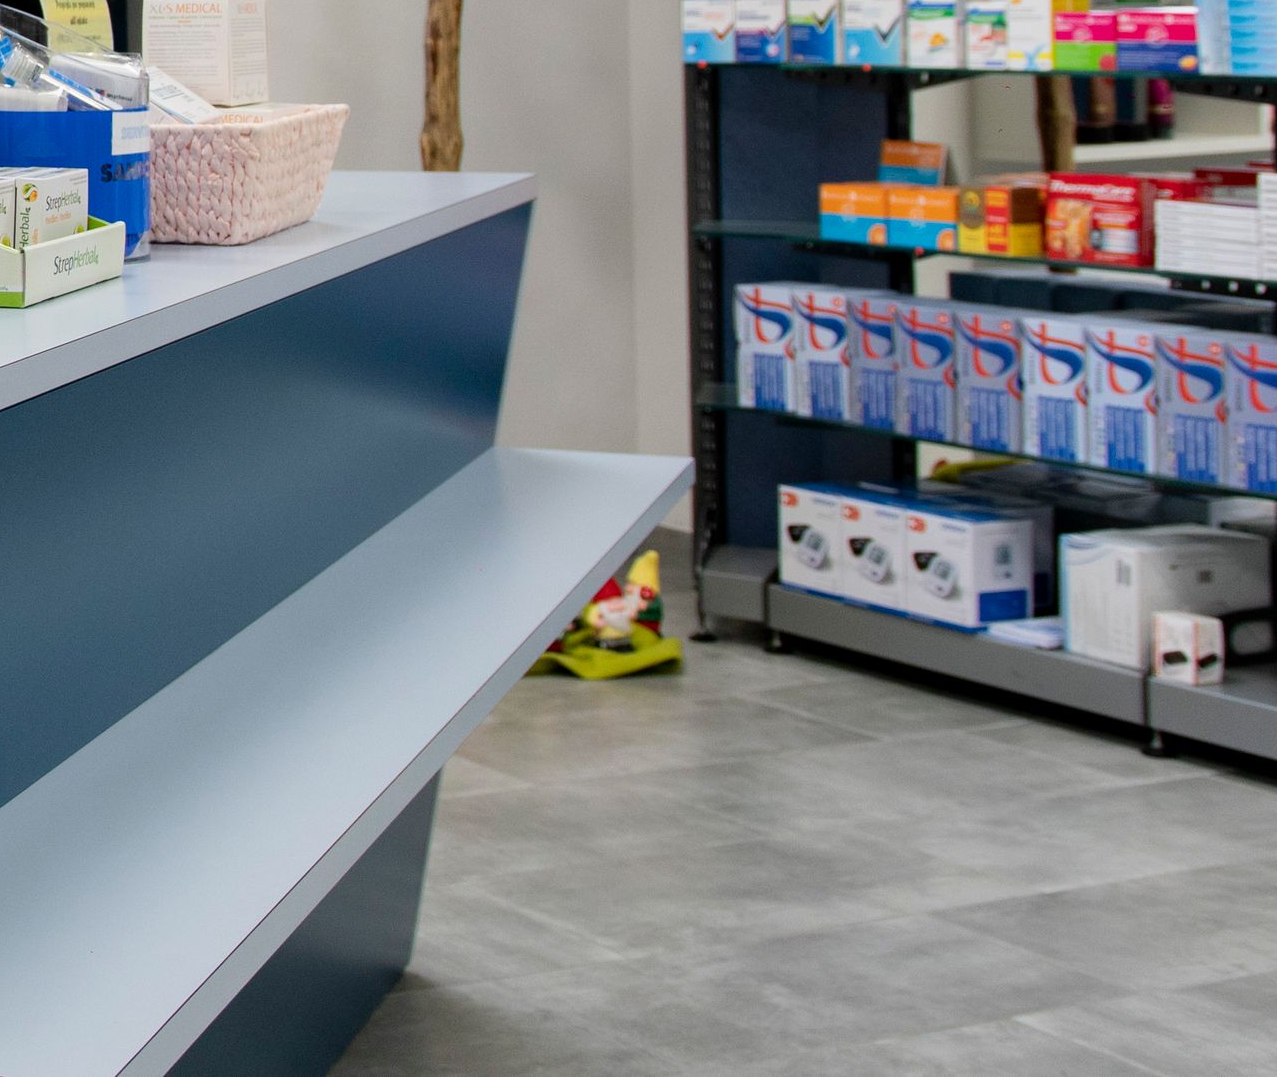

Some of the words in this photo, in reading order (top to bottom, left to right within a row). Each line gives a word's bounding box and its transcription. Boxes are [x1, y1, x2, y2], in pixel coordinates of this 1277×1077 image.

[175, 2, 223, 14] MEDICAL
[46, 189, 79, 212] StrepHerbal
[19, 210, 30, 251] Herbal
[53, 246, 98, 275] StrepHerbal
